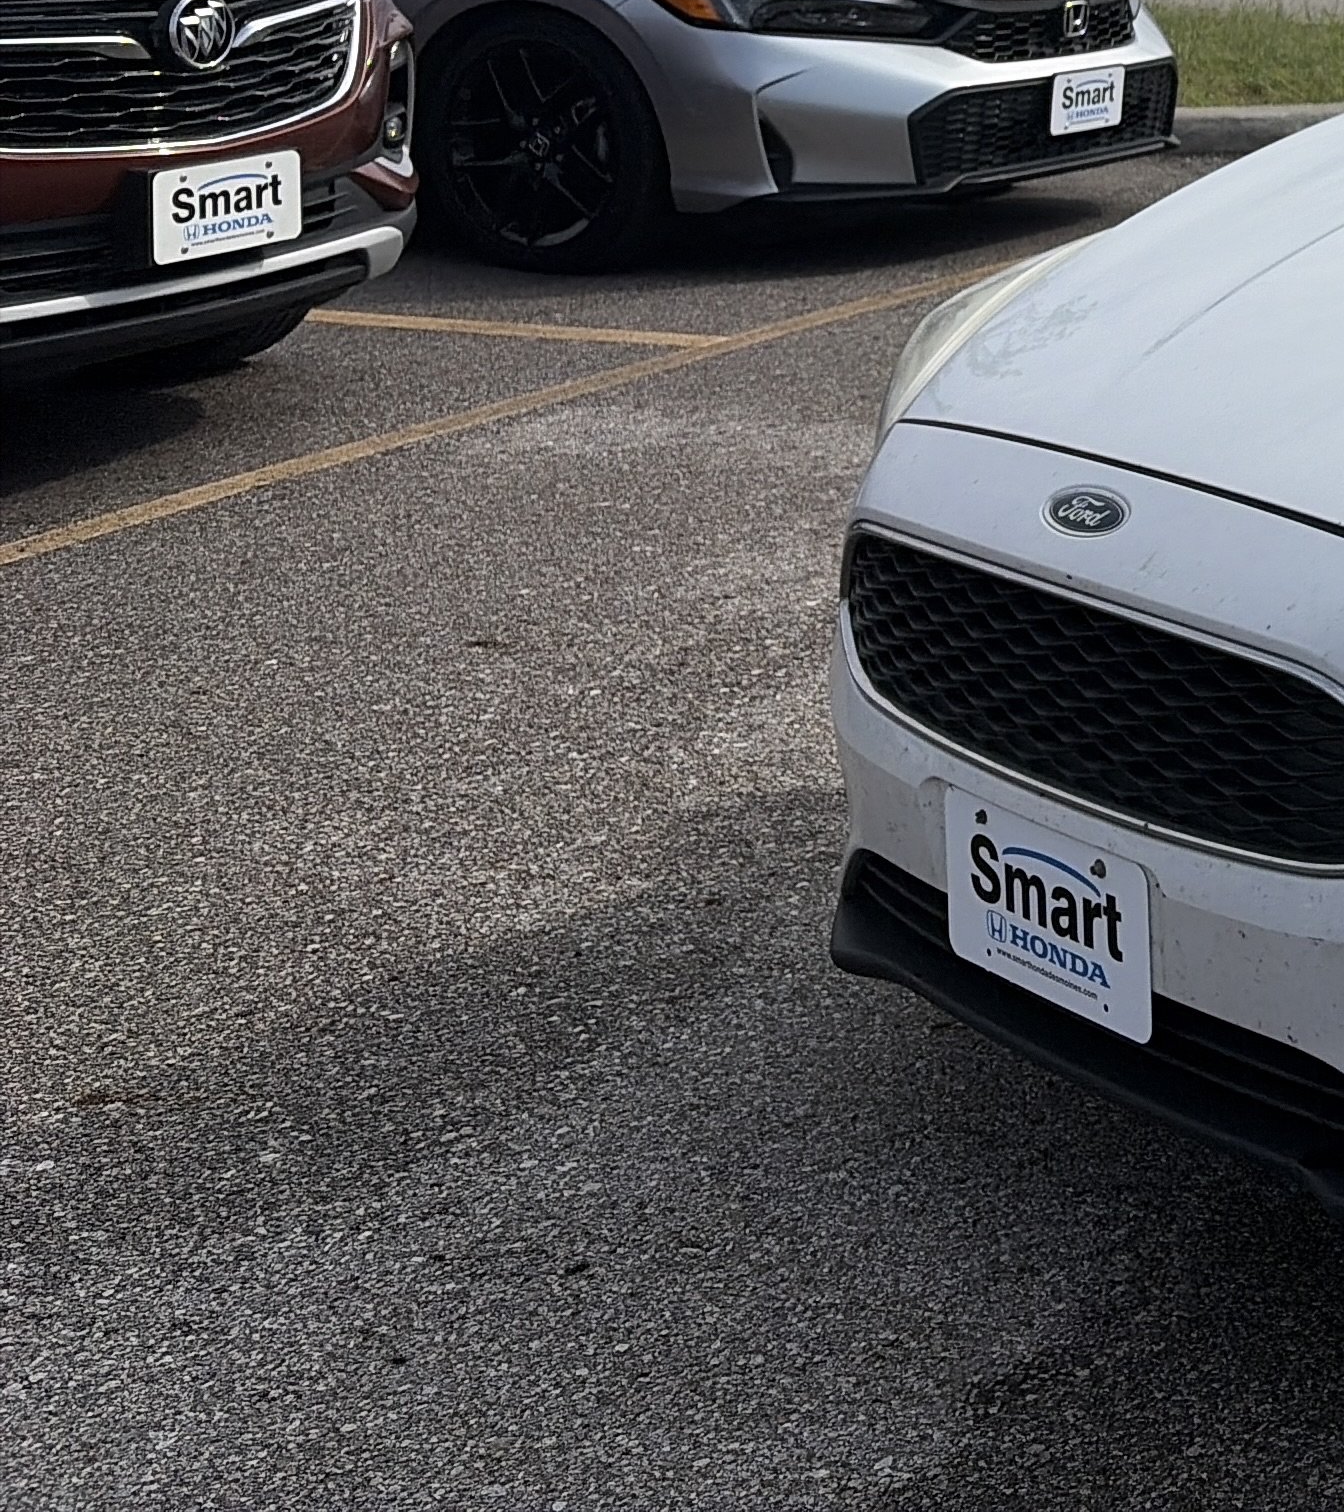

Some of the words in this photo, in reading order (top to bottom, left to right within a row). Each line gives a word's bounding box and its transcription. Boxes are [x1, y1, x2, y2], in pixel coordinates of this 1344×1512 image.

[1062, 80, 1115, 109] Smart
[1075, 106, 1109, 119] HONDA
[171, 174, 282, 224] Smart
[202, 213, 273, 236] HONDA
[1057, 495, 1111, 526] Ford
[970, 833, 1123, 962] Smart
[1009, 923, 1111, 989] HONDA
